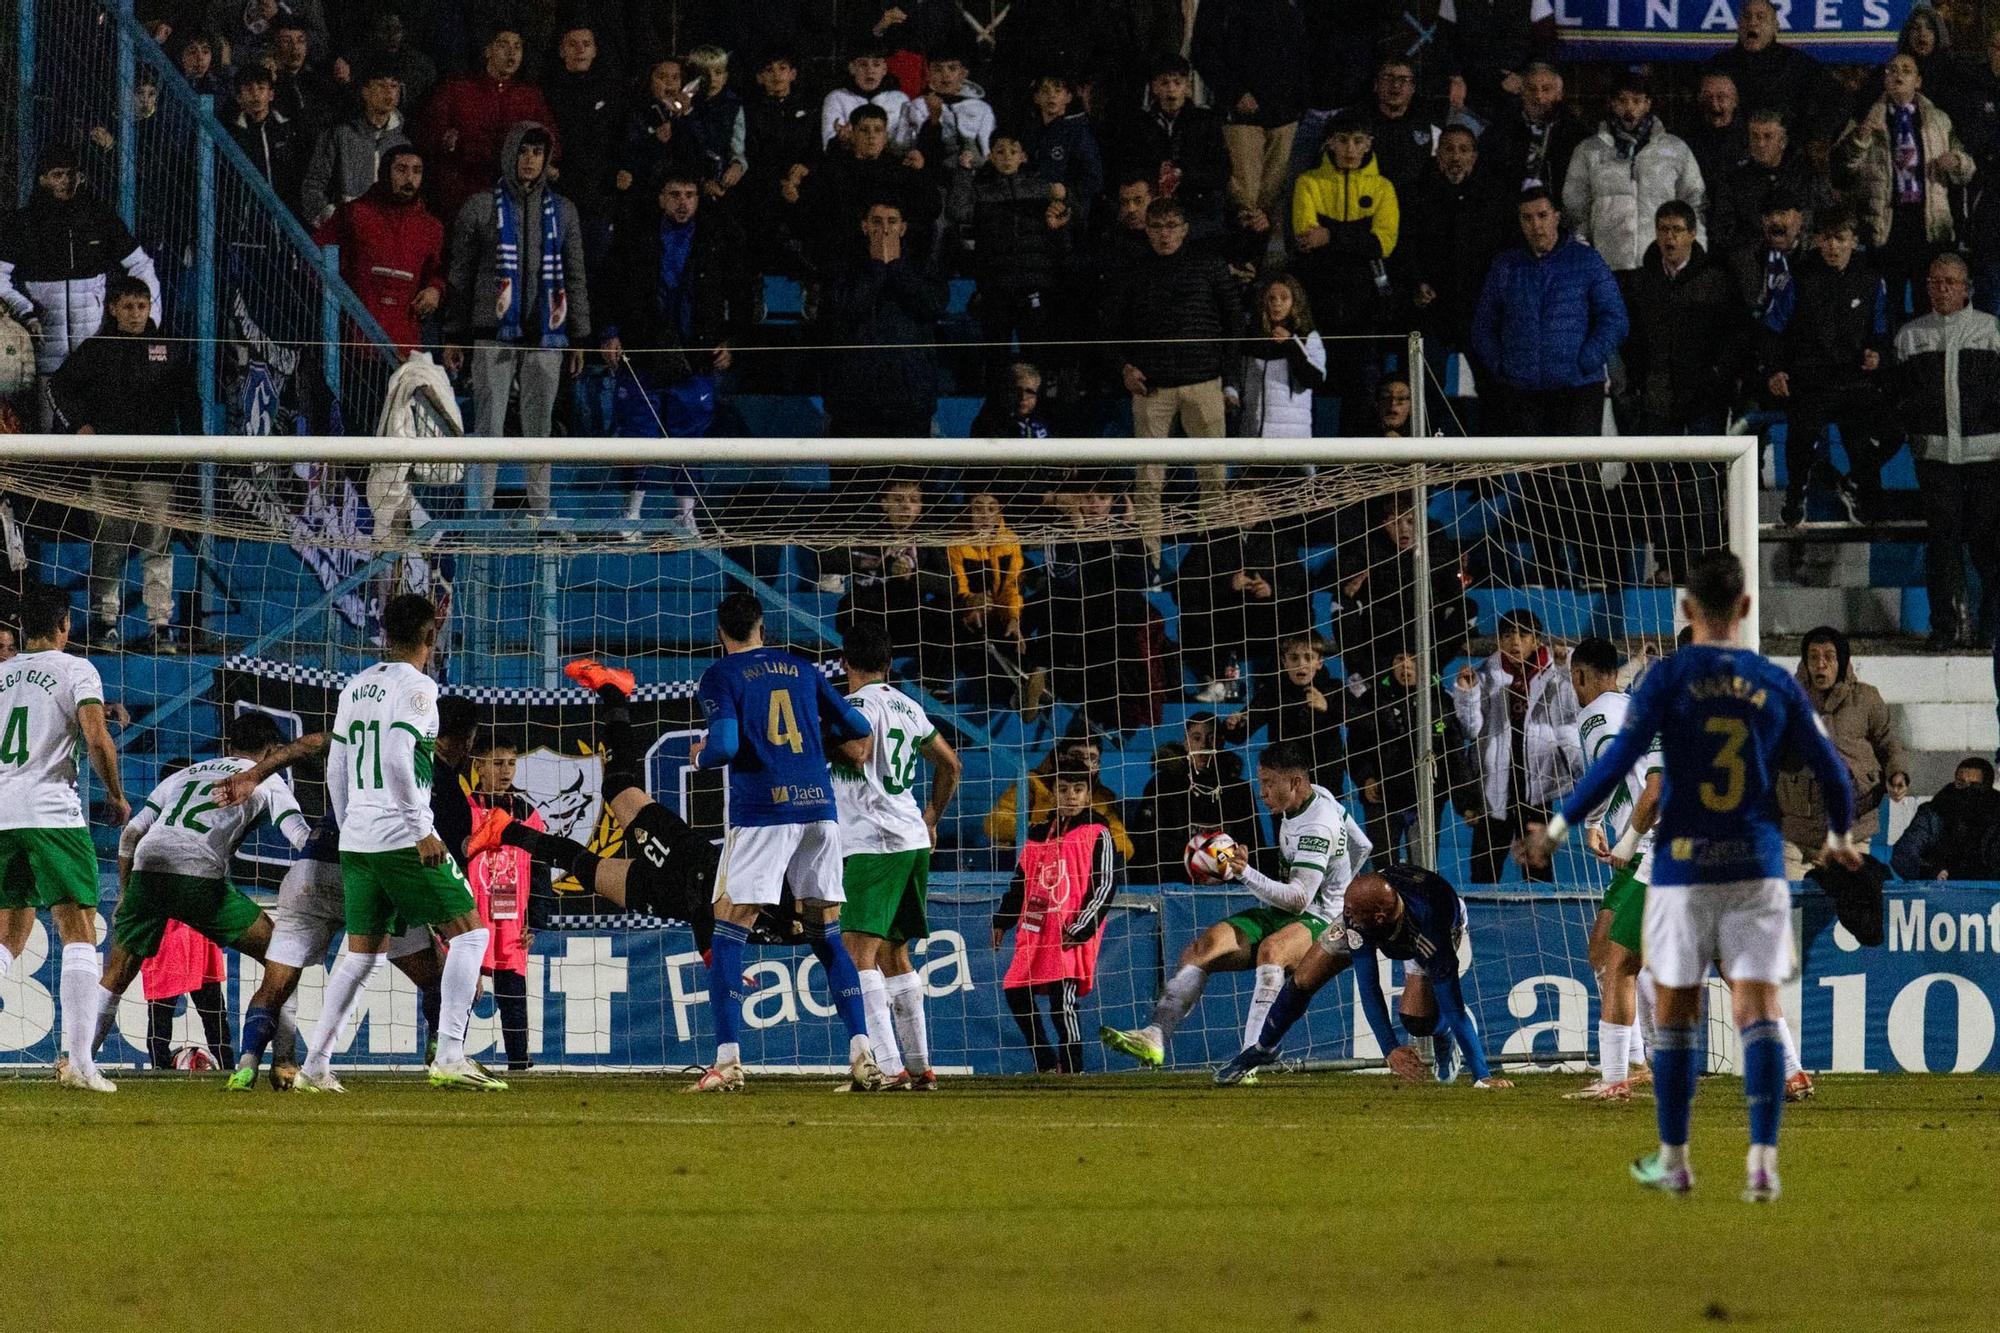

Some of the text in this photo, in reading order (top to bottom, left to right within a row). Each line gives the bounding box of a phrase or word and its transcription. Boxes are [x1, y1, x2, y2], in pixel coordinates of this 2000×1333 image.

[1553, 0, 1891, 30] LINARES
[1, 706, 29, 768] 4
[767, 689, 803, 754] 4
[349, 720, 384, 790] 21
[1700, 717, 1748, 812] 3
[165, 780, 222, 834] 12
[789, 784, 824, 801] Jaén
[644, 836, 671, 868] 13
